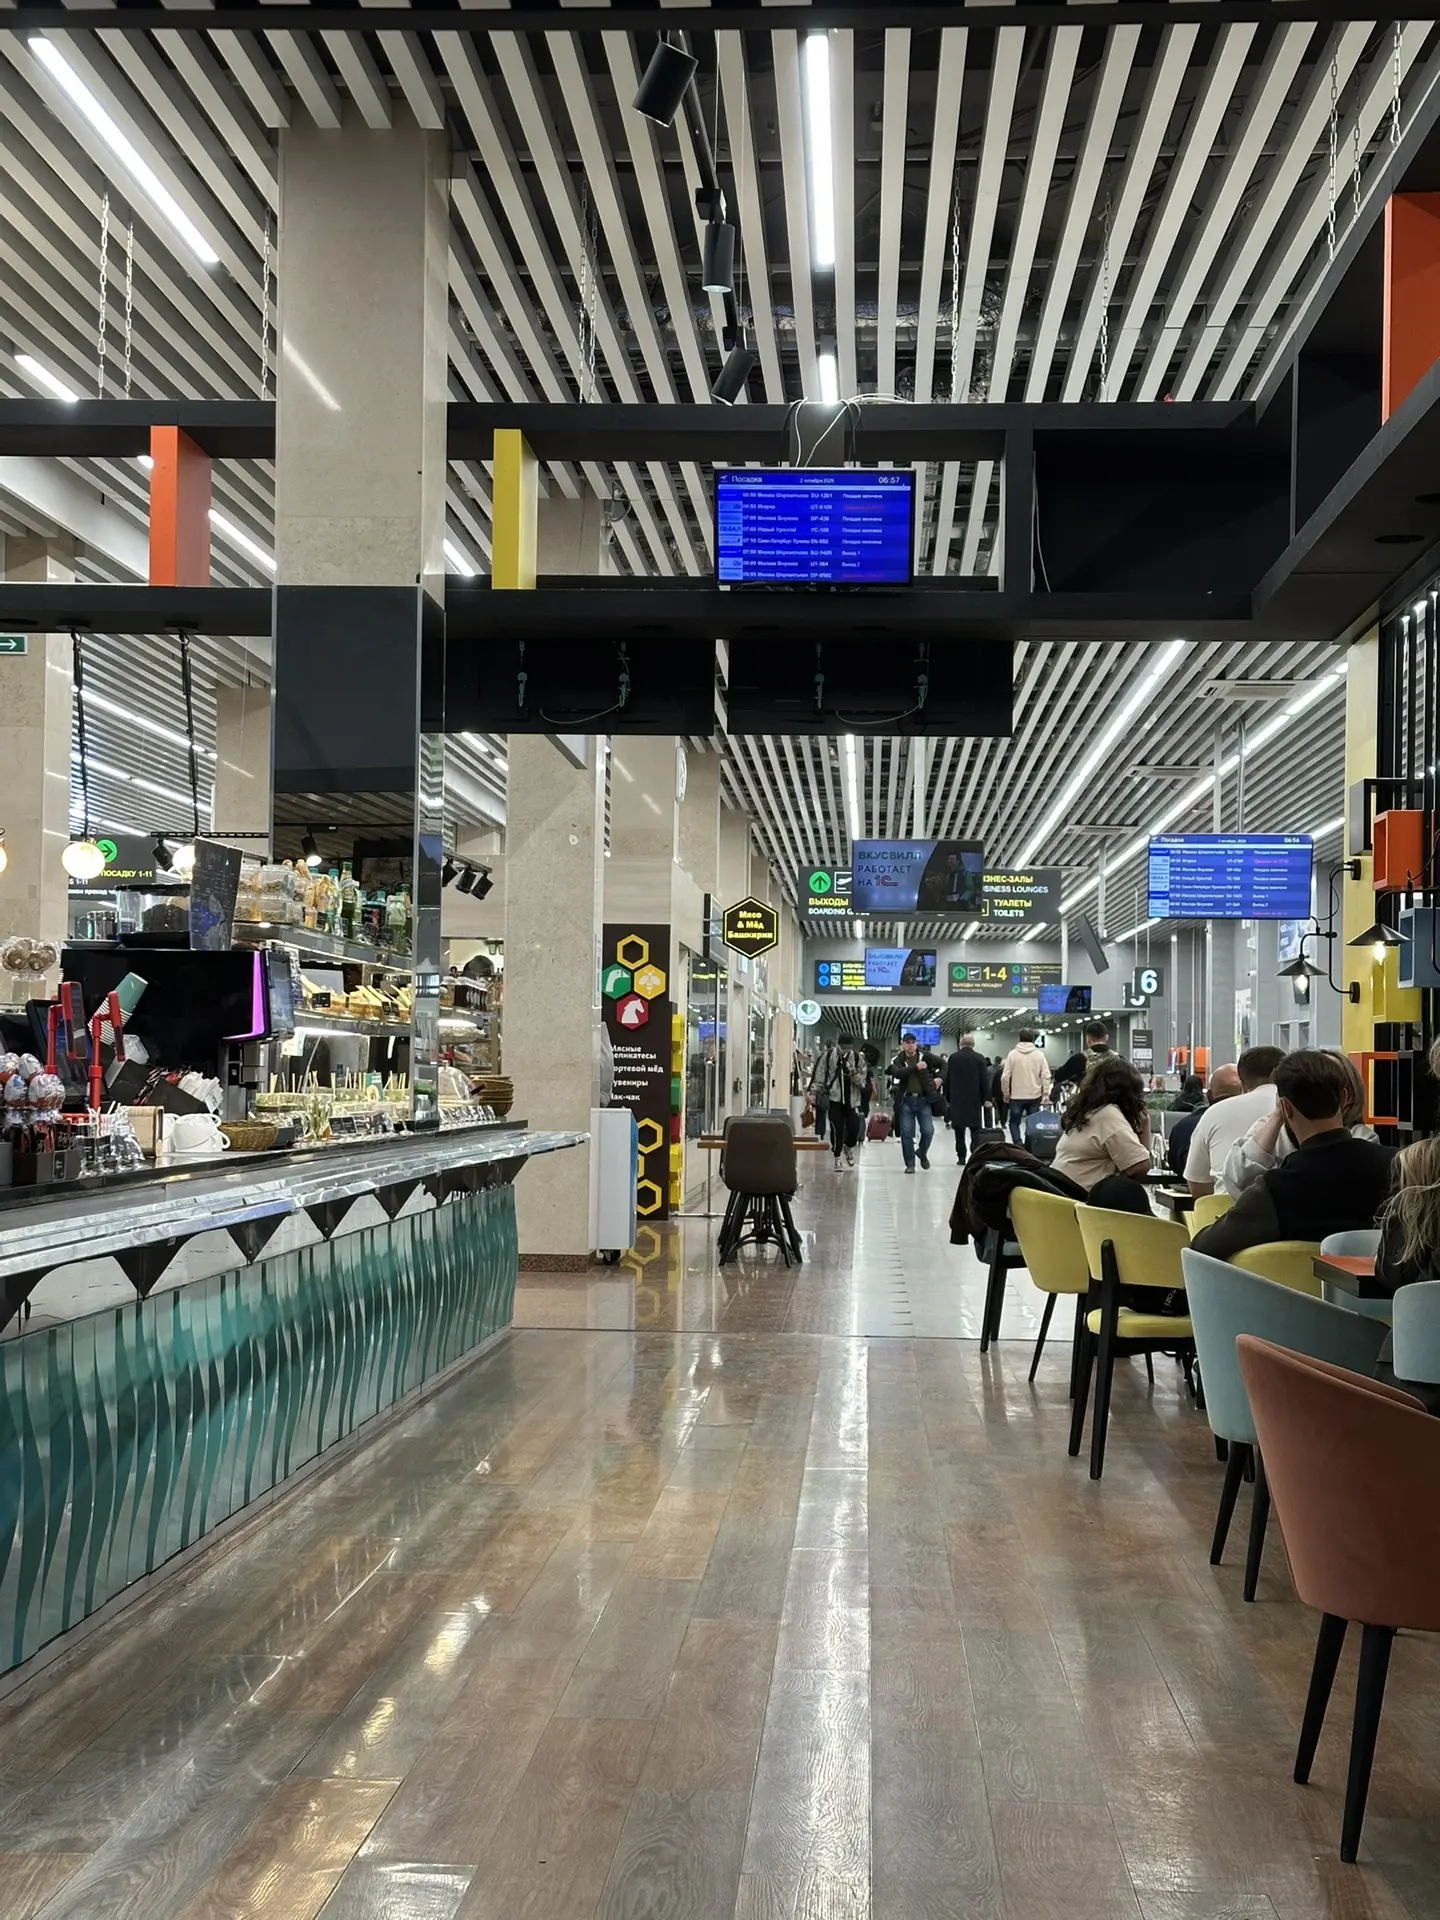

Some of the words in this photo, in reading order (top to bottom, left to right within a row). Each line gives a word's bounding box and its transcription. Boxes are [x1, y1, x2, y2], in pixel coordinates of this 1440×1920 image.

[731, 475, 763, 484] Посадка
[878, 476, 900, 484] 06:57
[858, 851, 922, 860] ВКУСВИЛЛ
[858, 865, 912, 873] РАБОТАЕТ
[101, 870, 136, 878] ПОСАДКУ
[858, 878, 873, 886] НА
[808, 898, 849, 906] ВЫХОДЫ
[993, 899, 1032, 907] ТУАЛЕТЫ
[739, 910, 762, 919] Мясо
[993, 909, 1025, 917] TOILETS
[737, 920, 745, 929] &
[746, 920, 765, 930] Мёд
[727, 930, 773, 940] Башкирии
[982, 966, 1008, 981] 1-4
[1140, 969, 1158, 994] 6
[1033, 1035, 1044, 1048] 4
[613, 1064, 647, 1074] ортевой
[647, 1064, 664, 1074] мёд
[613, 1080, 649, 1088] увениры
